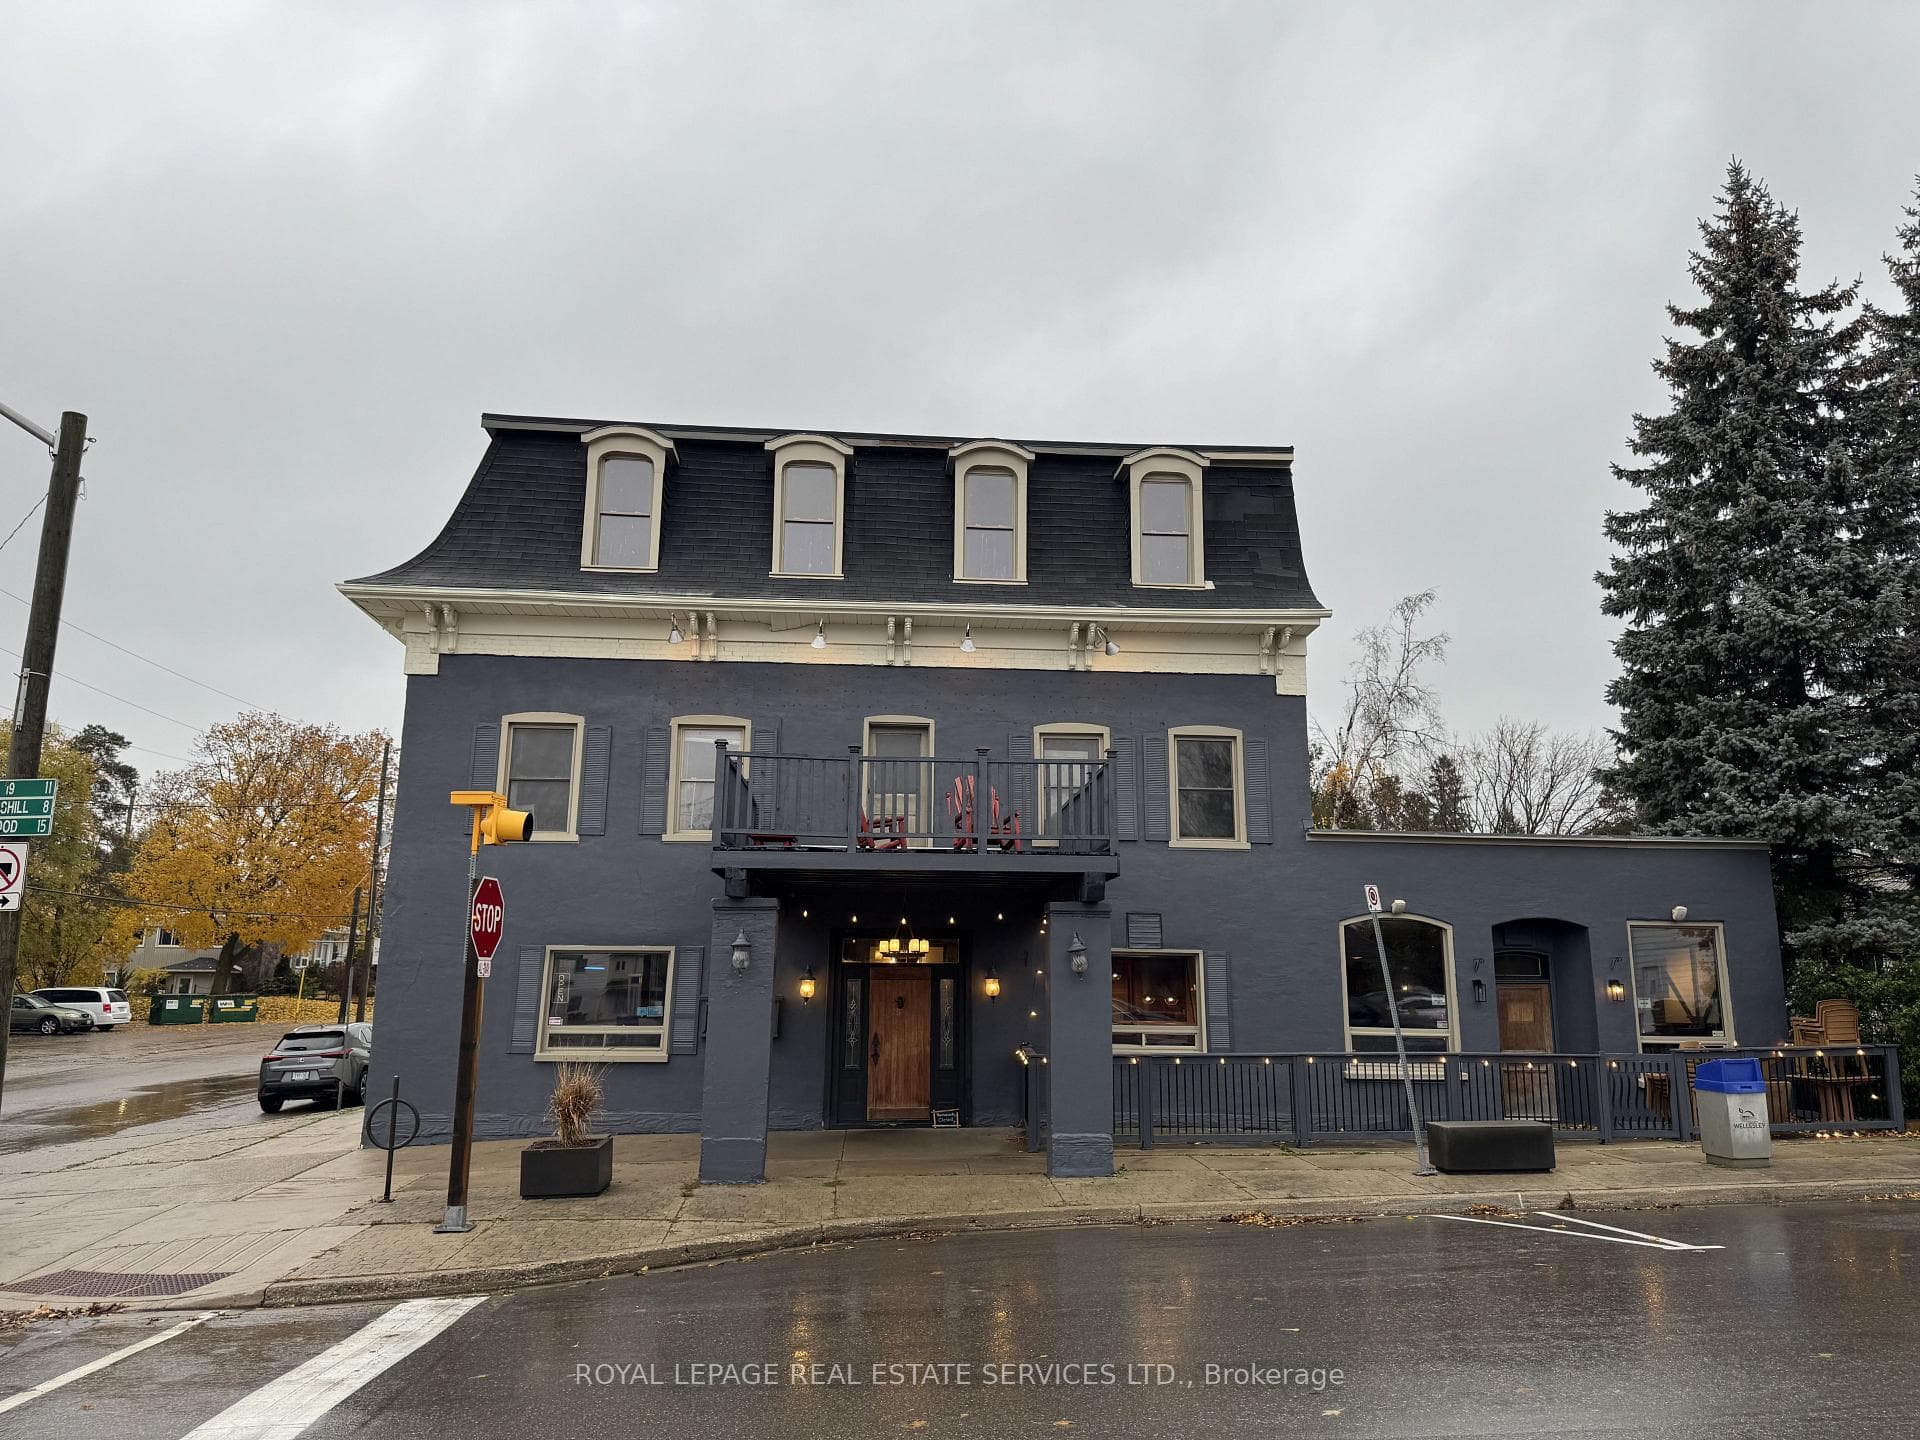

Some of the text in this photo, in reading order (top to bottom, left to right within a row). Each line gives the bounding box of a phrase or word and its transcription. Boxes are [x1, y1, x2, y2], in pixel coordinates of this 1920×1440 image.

[45, 781, 52, 794] 11
[42, 800, 50, 813] 8
[37, 819, 47, 833] 15
[474, 903, 501, 933] STOP
